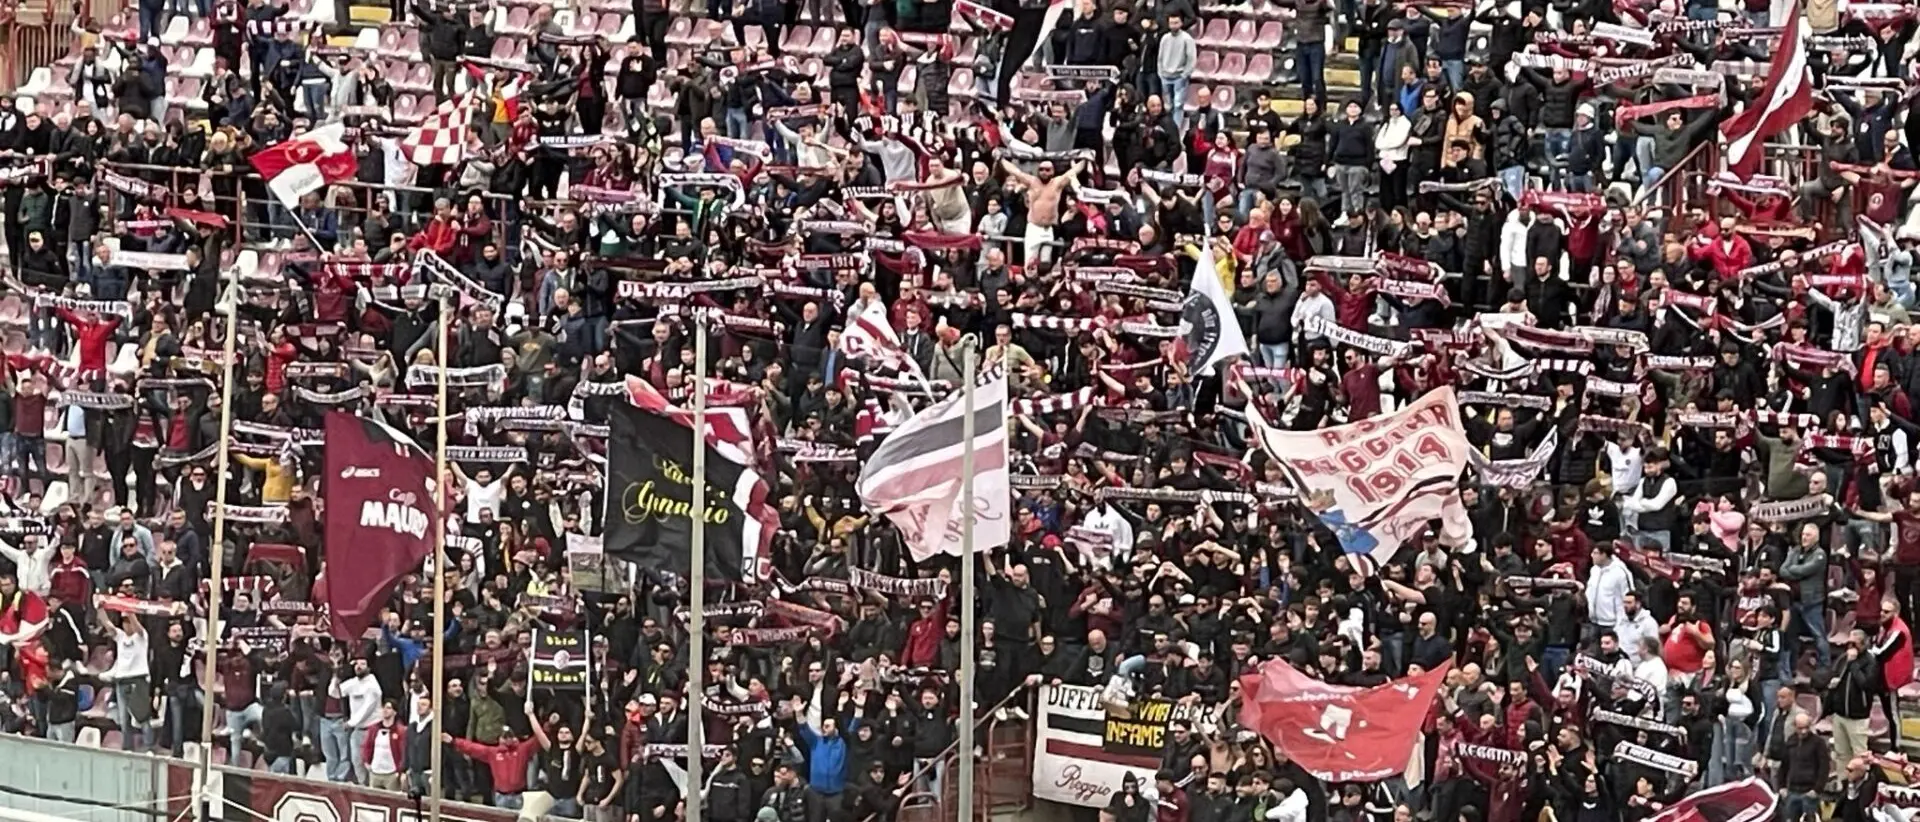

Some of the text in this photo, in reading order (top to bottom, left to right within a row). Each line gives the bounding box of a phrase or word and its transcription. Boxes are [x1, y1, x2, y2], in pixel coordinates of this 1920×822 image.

[1348, 435, 1450, 504] 1914
[1106, 720, 1165, 748] INFAME
[1459, 743, 1523, 767] REGGINA
[1055, 764, 1111, 801] Reggio
